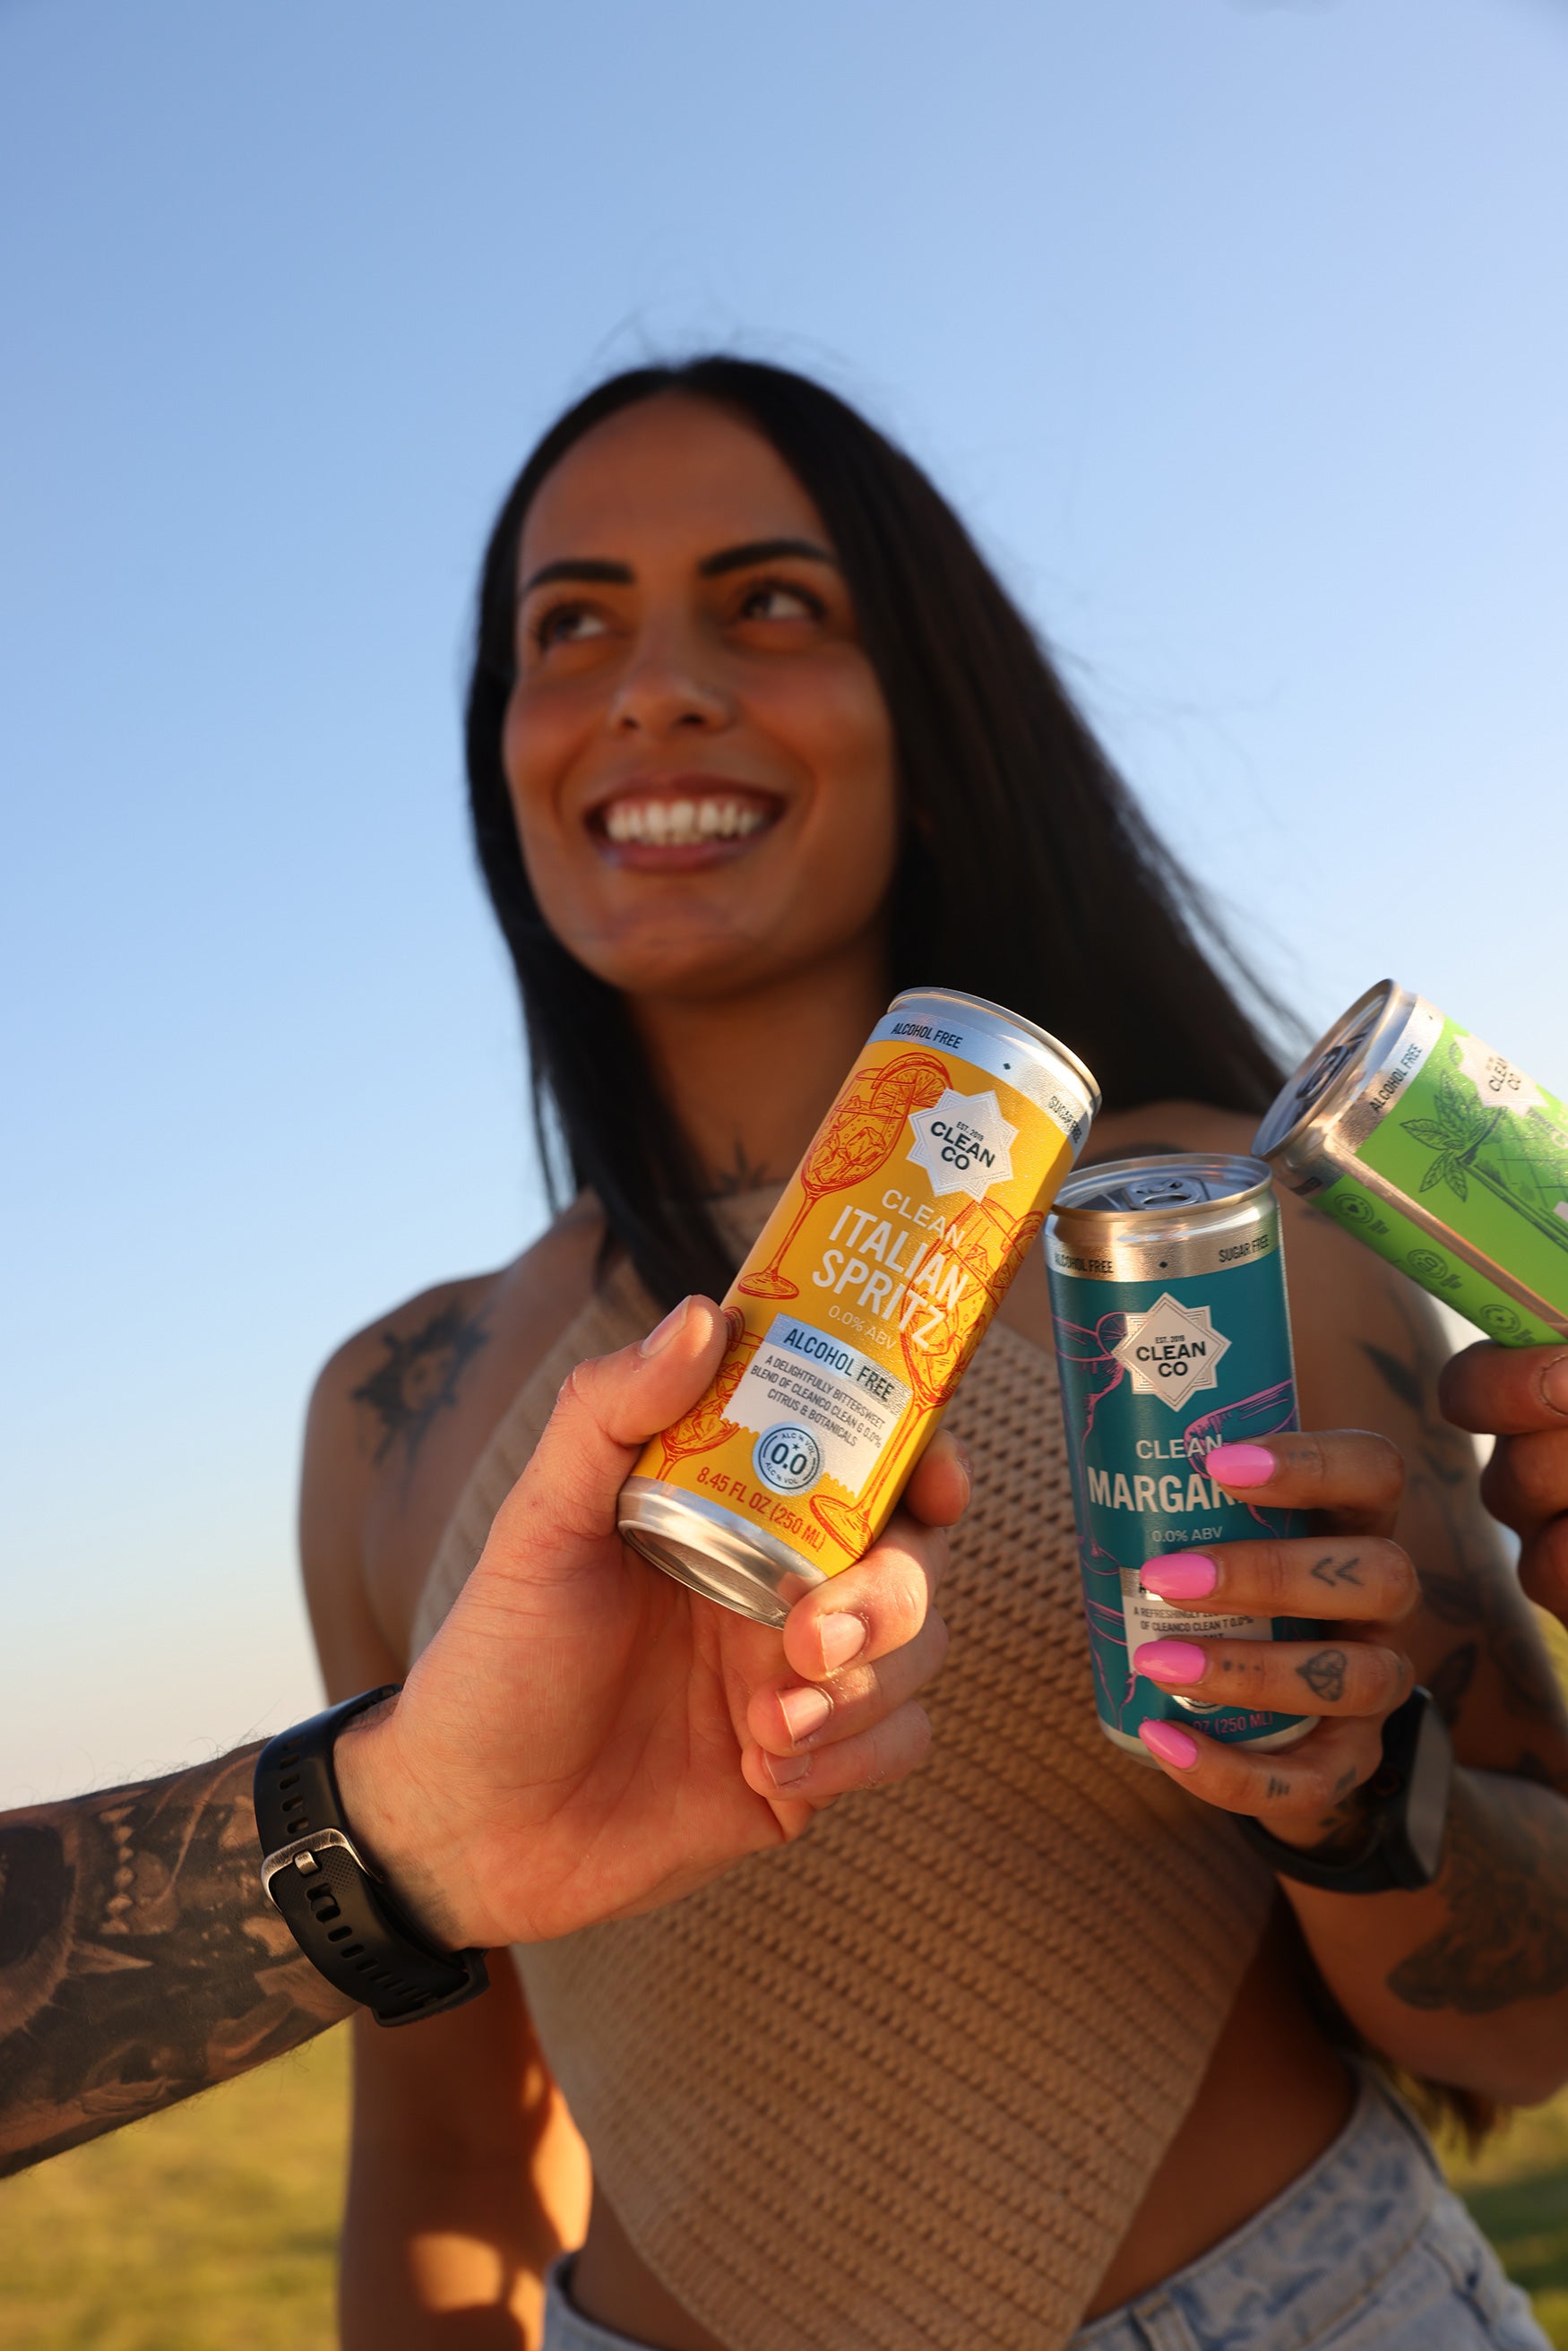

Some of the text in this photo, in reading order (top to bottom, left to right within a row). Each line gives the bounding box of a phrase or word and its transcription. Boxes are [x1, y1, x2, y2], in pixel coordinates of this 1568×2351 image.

[891, 1022, 964, 1049] ALCOHOL FREE
[1369, 1043, 1423, 1113] ALCOHOL FREE
[930, 1121, 995, 1168] CLEAN
[941, 1146, 969, 1170] CO
[882, 1189, 965, 1249] CLEAN
[829, 1205, 969, 1310] ITALIAN
[1089, 1259, 1114, 1273] FREE
[1219, 1243, 1250, 1262] SUGAR
[812, 1249, 946, 1349] SPRITZ
[828, 1305, 897, 1350] 0.0% ABV
[783, 1328, 895, 1402] ALCOHOL FREE
[1136, 1340, 1206, 1362] CLEAN
[1158, 1361, 1188, 1378] CO
[751, 1365, 779, 1383] BLEND
[779, 1377, 792, 1389] OF
[791, 1383, 831, 1411] CLEANCO
[831, 1405, 858, 1429] CLEAN
[863, 1427, 882, 1449] 0.0%
[765, 1355, 885, 1429] A DELIGHTFULLY BITTERSWEET
[767, 1388, 858, 1447] CITRUS & BOTANICALS
[771, 1442, 807, 1476] 0.0
[1135, 1434, 1222, 1460] CLEAN
[764, 1462, 777, 1477] ALC
[1087, 1466, 1244, 1513] MARGAR
[697, 1467, 826, 1553] 8.45 FL OZ (250 ML)
[1151, 1526, 1223, 1542] 0.0% ABV
[1133, 1606, 1139, 1615] A
[1141, 1621, 1150, 1630] OF
[1152, 1622, 1190, 1632] CLEANCO
[1193, 1621, 1221, 1632] CLEAN
[1222, 1619, 1228, 1628] T
[1214, 1716, 1246, 1735] (250
[1249, 1712, 1273, 1728] ML)
